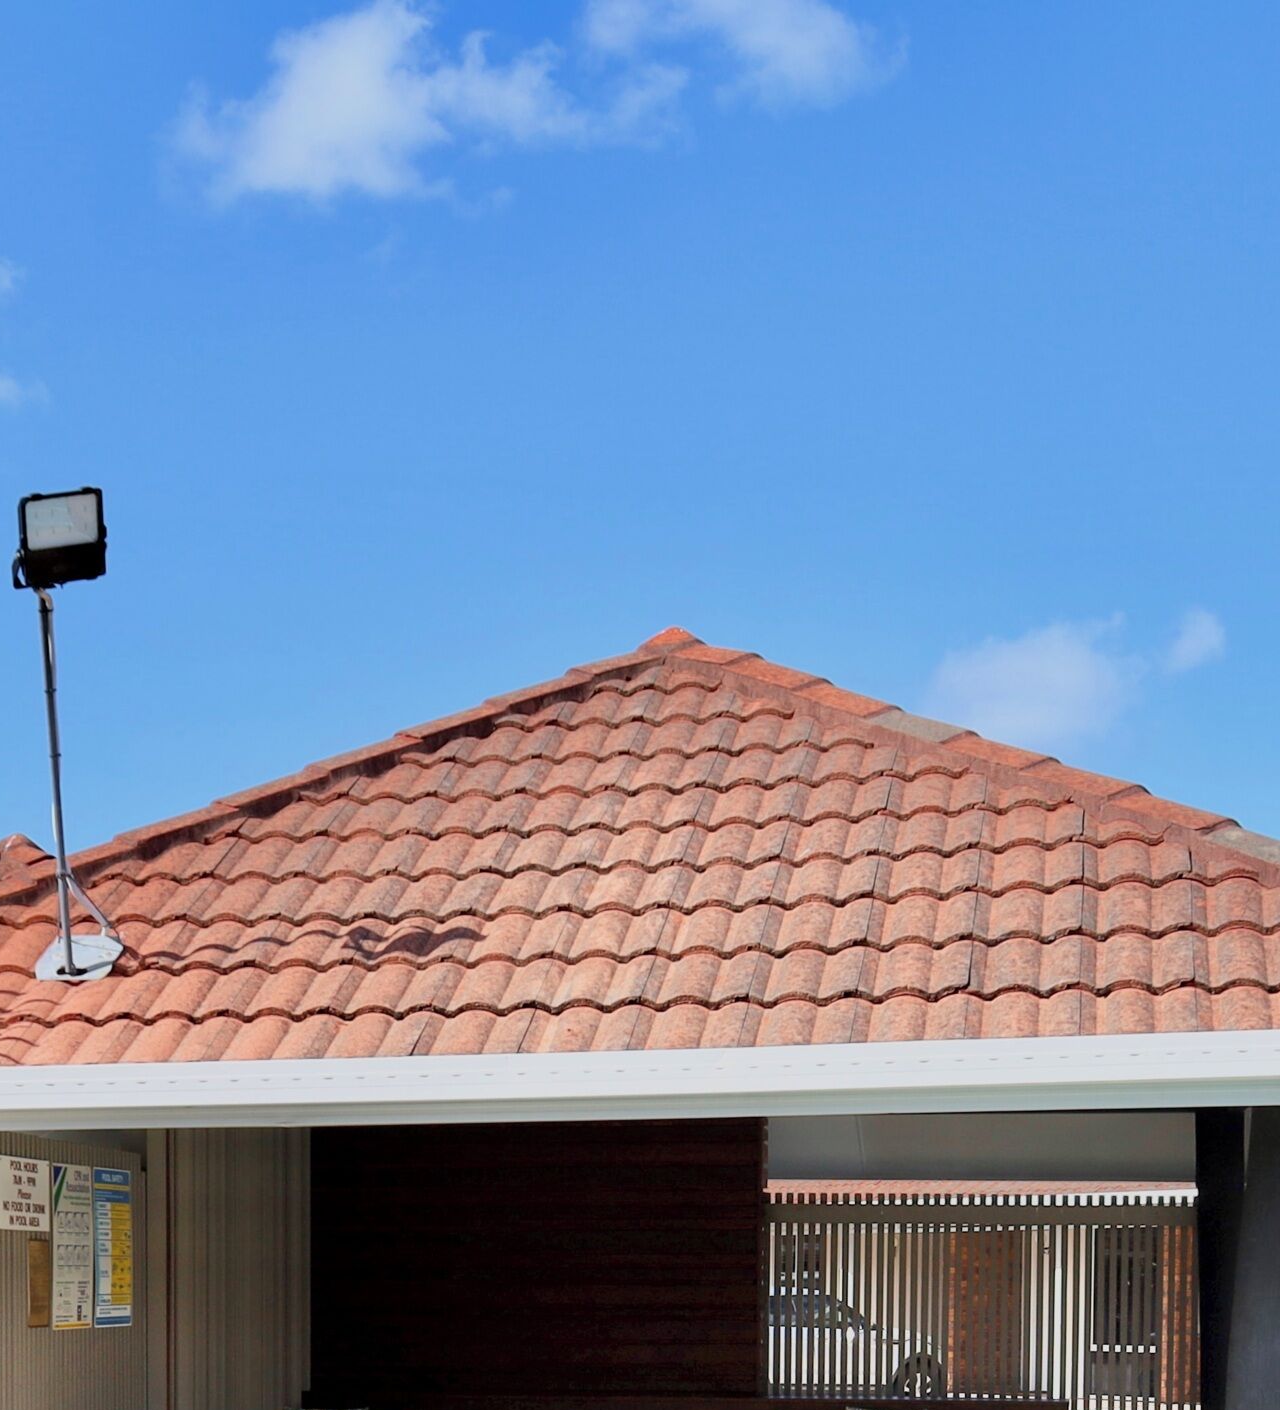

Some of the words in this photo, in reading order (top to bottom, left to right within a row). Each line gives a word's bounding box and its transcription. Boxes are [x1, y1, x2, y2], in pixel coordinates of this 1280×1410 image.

[10, 1160, 22, 1171] POOL
[23, 1162, 38, 1173] HOURS
[17, 1189, 31, 1200] Please
[3, 1201, 9, 1211] NO
[11, 1201, 23, 1212] FOOD
[25, 1203, 31, 1213] OR
[32, 1203, 45, 1214] DRINK
[9, 1215, 14, 1225] IN
[15, 1216, 27, 1226] POOL
[29, 1217, 40, 1227] AREA
